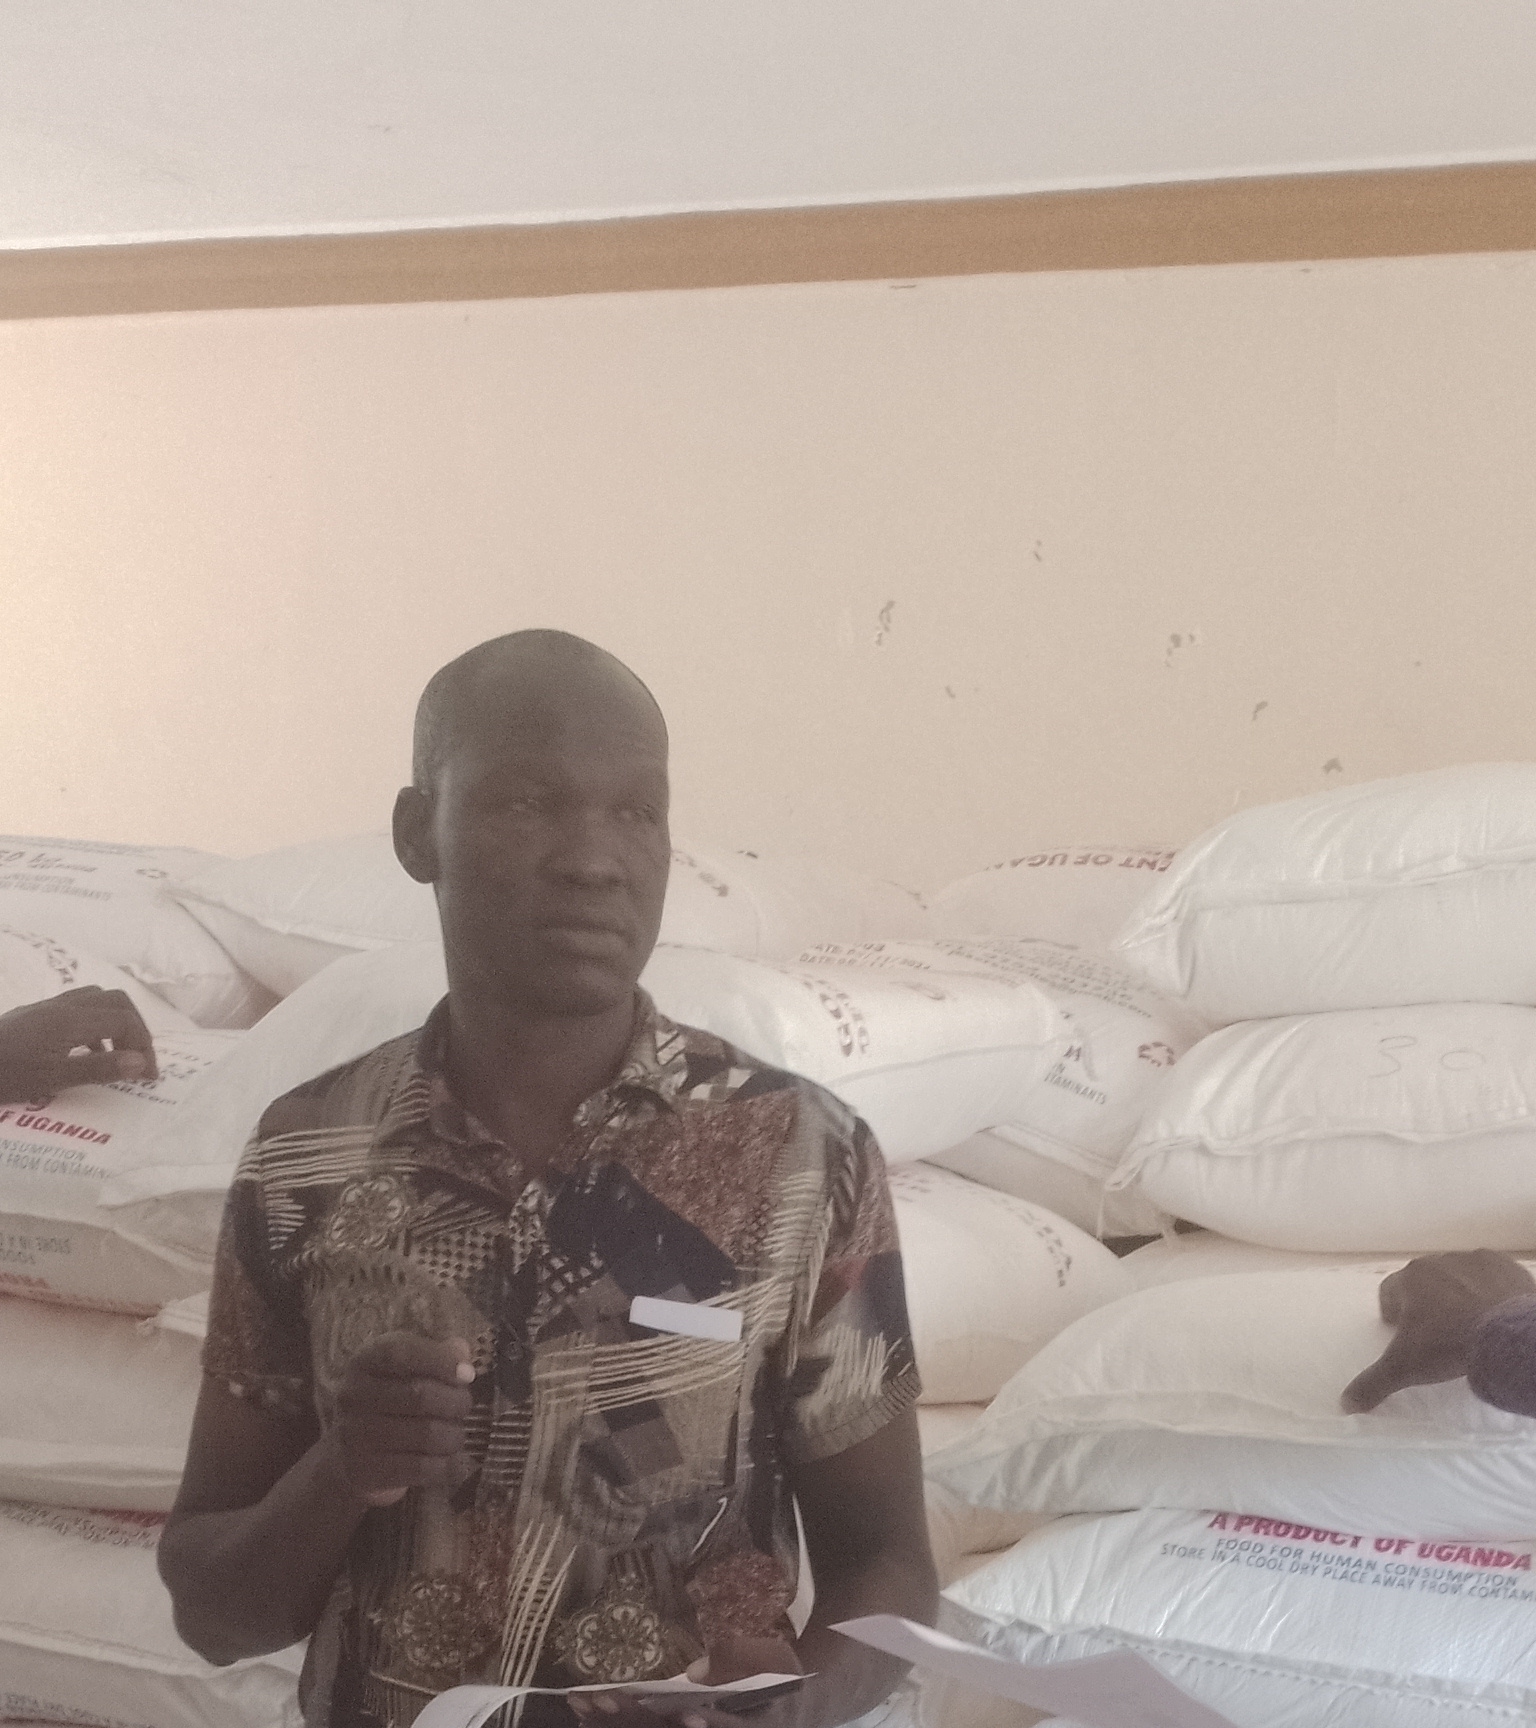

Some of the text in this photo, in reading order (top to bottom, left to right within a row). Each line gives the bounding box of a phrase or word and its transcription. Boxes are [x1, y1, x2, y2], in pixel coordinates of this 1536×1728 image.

[16, 1113, 112, 1145] UGANDA
[1207, 1512, 1532, 1571] A PRODUCT OF UGANDA
[1216, 1538, 1519, 1587] FOOD FOR HUMAN CONSUMPTION
[1160, 1542, 1205, 1560] STORE
[1211, 1550, 1226, 1563] IN
[1229, 1552, 1241, 1565] A
[1246, 1555, 1283, 1572] COOL
[1289, 1560, 1321, 1576] DRY
[1322, 1566, 1369, 1585] PLACE
[1372, 1575, 1414, 1592] AWAY
[1421, 1579, 1463, 1596] FROM
